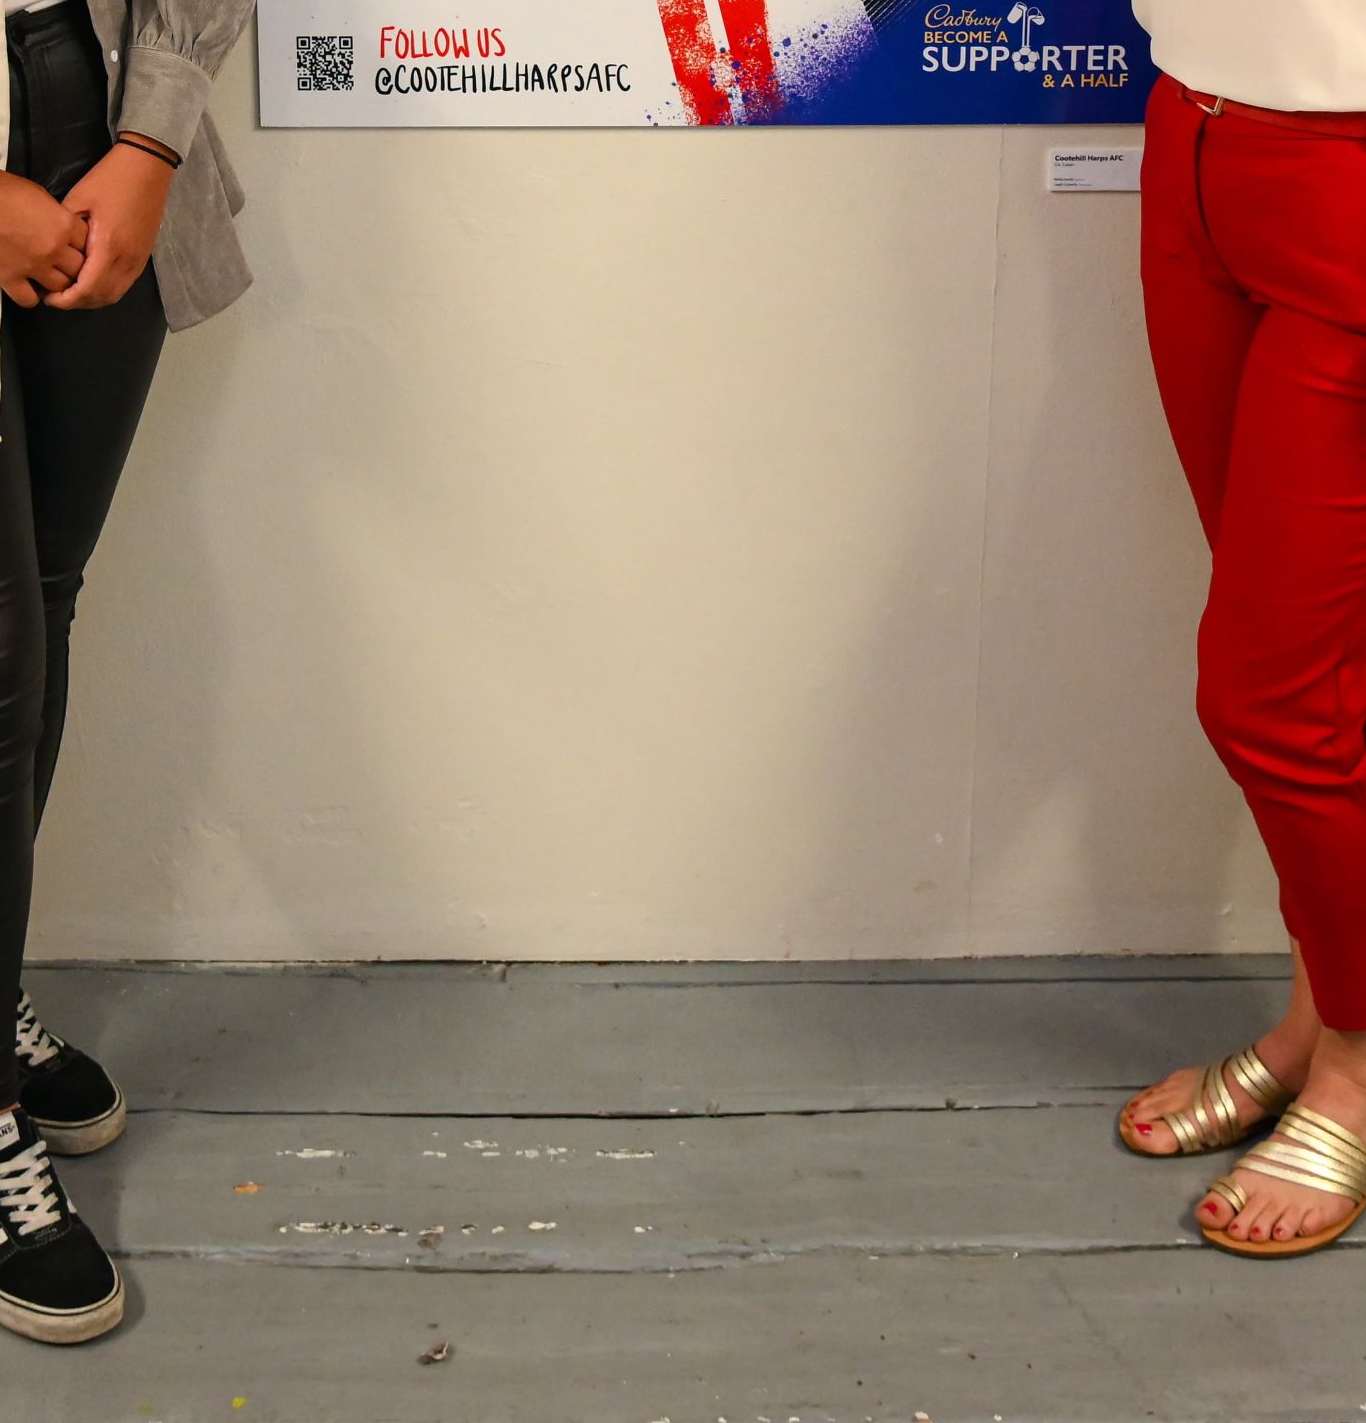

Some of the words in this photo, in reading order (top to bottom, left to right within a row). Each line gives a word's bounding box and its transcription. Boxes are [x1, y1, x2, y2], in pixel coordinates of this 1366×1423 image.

[925, 4, 1002, 31] Cadbury
[380, 26, 470, 58] FOLLOW
[477, 28, 505, 57] US
[924, 31, 991, 43] BECOME
[997, 31, 1008, 43] A
[922, 45, 1128, 72] SUPPORTER
[375, 62, 631, 94] @COOTEHILLHARPSAFC
[1042, 74, 1055, 88] &
[1061, 74, 1074, 88] A
[1081, 73, 1128, 88] HALF
[1055, 154, 1086, 162] Cootehill
[1110, 154, 1123, 162] AFC
